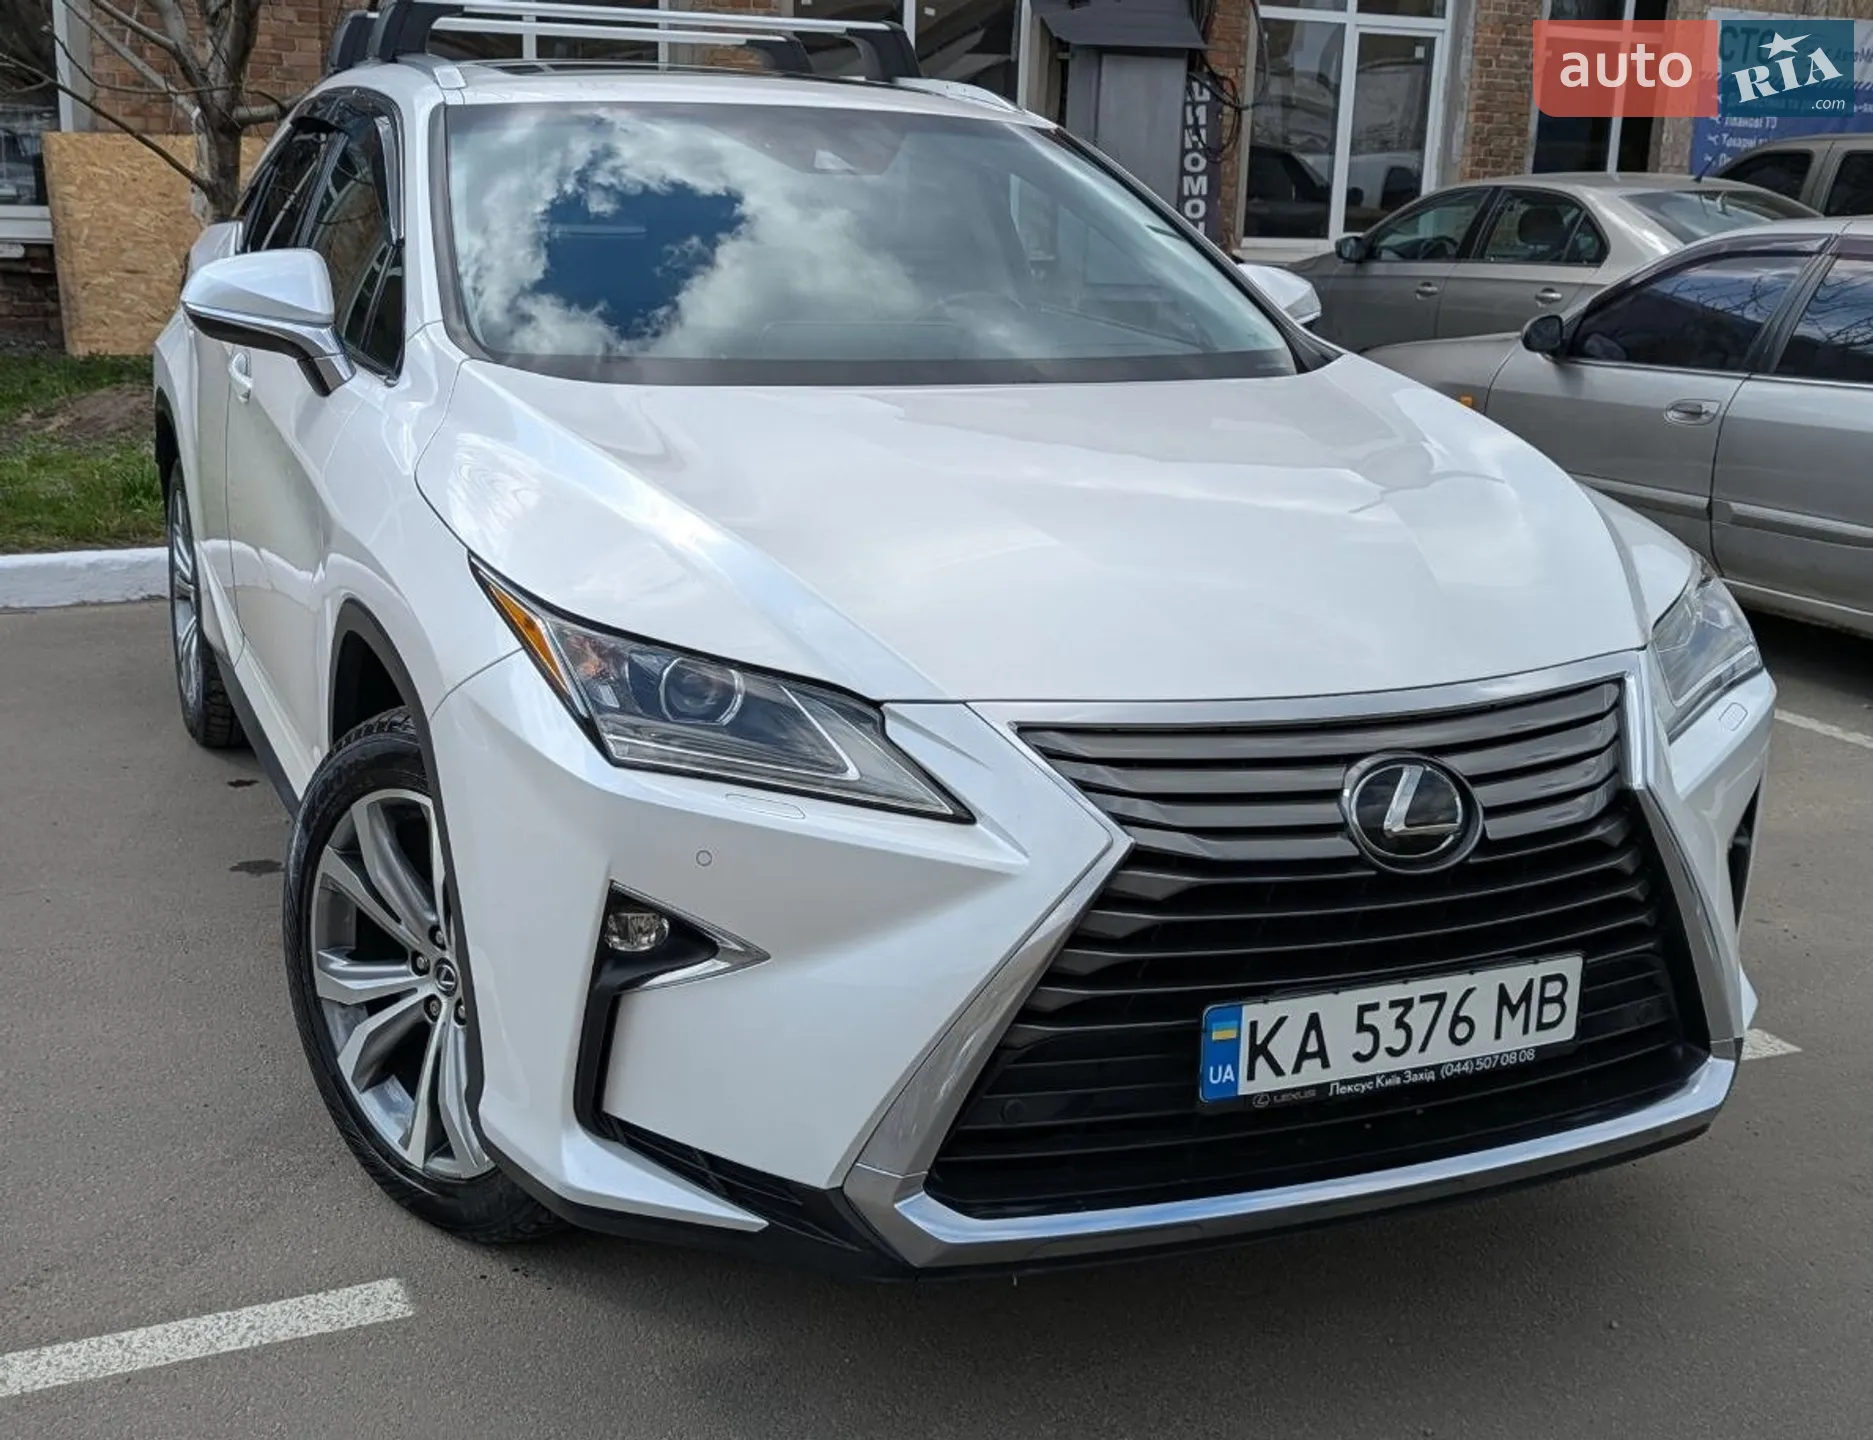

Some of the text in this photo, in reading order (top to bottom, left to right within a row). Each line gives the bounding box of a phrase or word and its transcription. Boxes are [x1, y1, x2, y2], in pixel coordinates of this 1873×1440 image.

[1246, 972, 1569, 1081] KA 5376 MB
[1208, 1065, 1235, 1085] UA
[1328, 1081, 1374, 1096] Лексус
[1403, 1068, 1435, 1083] Захід
[1440, 1060, 1474, 1079] (044)
[1474, 1054, 1499, 1070] 507
